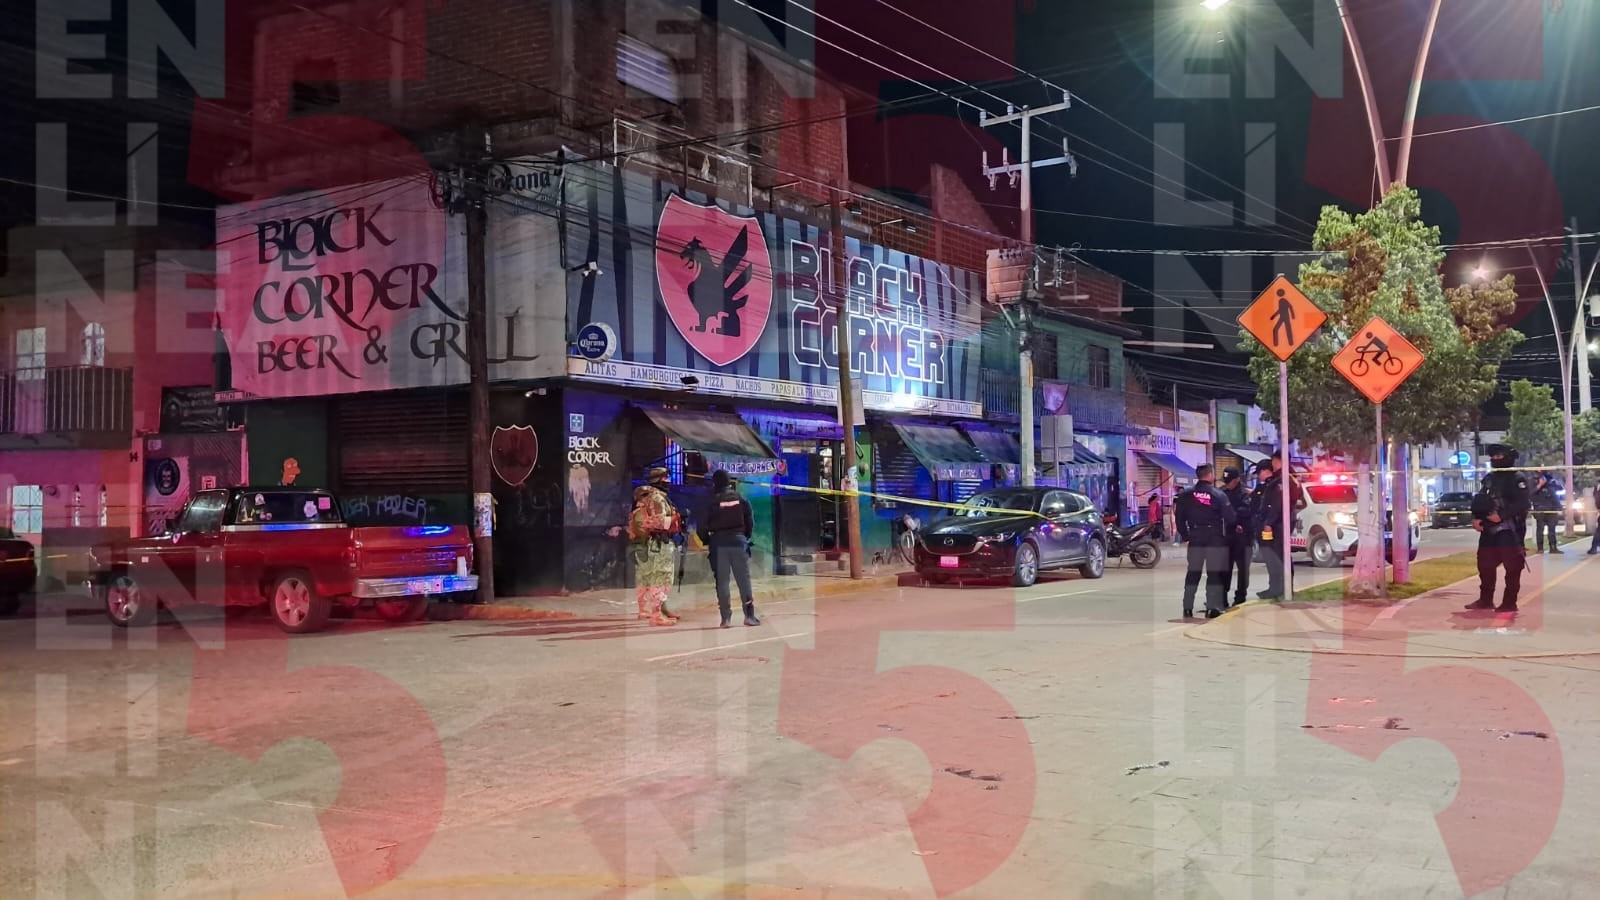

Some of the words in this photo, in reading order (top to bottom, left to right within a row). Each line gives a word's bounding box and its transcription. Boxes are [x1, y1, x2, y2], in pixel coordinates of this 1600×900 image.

[256, 203, 397, 271] BLACK
[253, 263, 470, 331] CORNER
[791, 239, 922, 326] BLACK
[257, 334, 362, 379] BEER
[363, 325, 388, 365] &
[411, 307, 540, 367] GRIL
[585, 362, 617, 376] ALITAS
[630, 367, 694, 386] HAMBURGUES
[705, 376, 725, 389] PIZZA
[735, 378, 762, 391] NACHOS
[792, 303, 944, 384] CORNER
[567, 450, 616, 467] CORNER
[568, 435, 600, 451] BLACK
